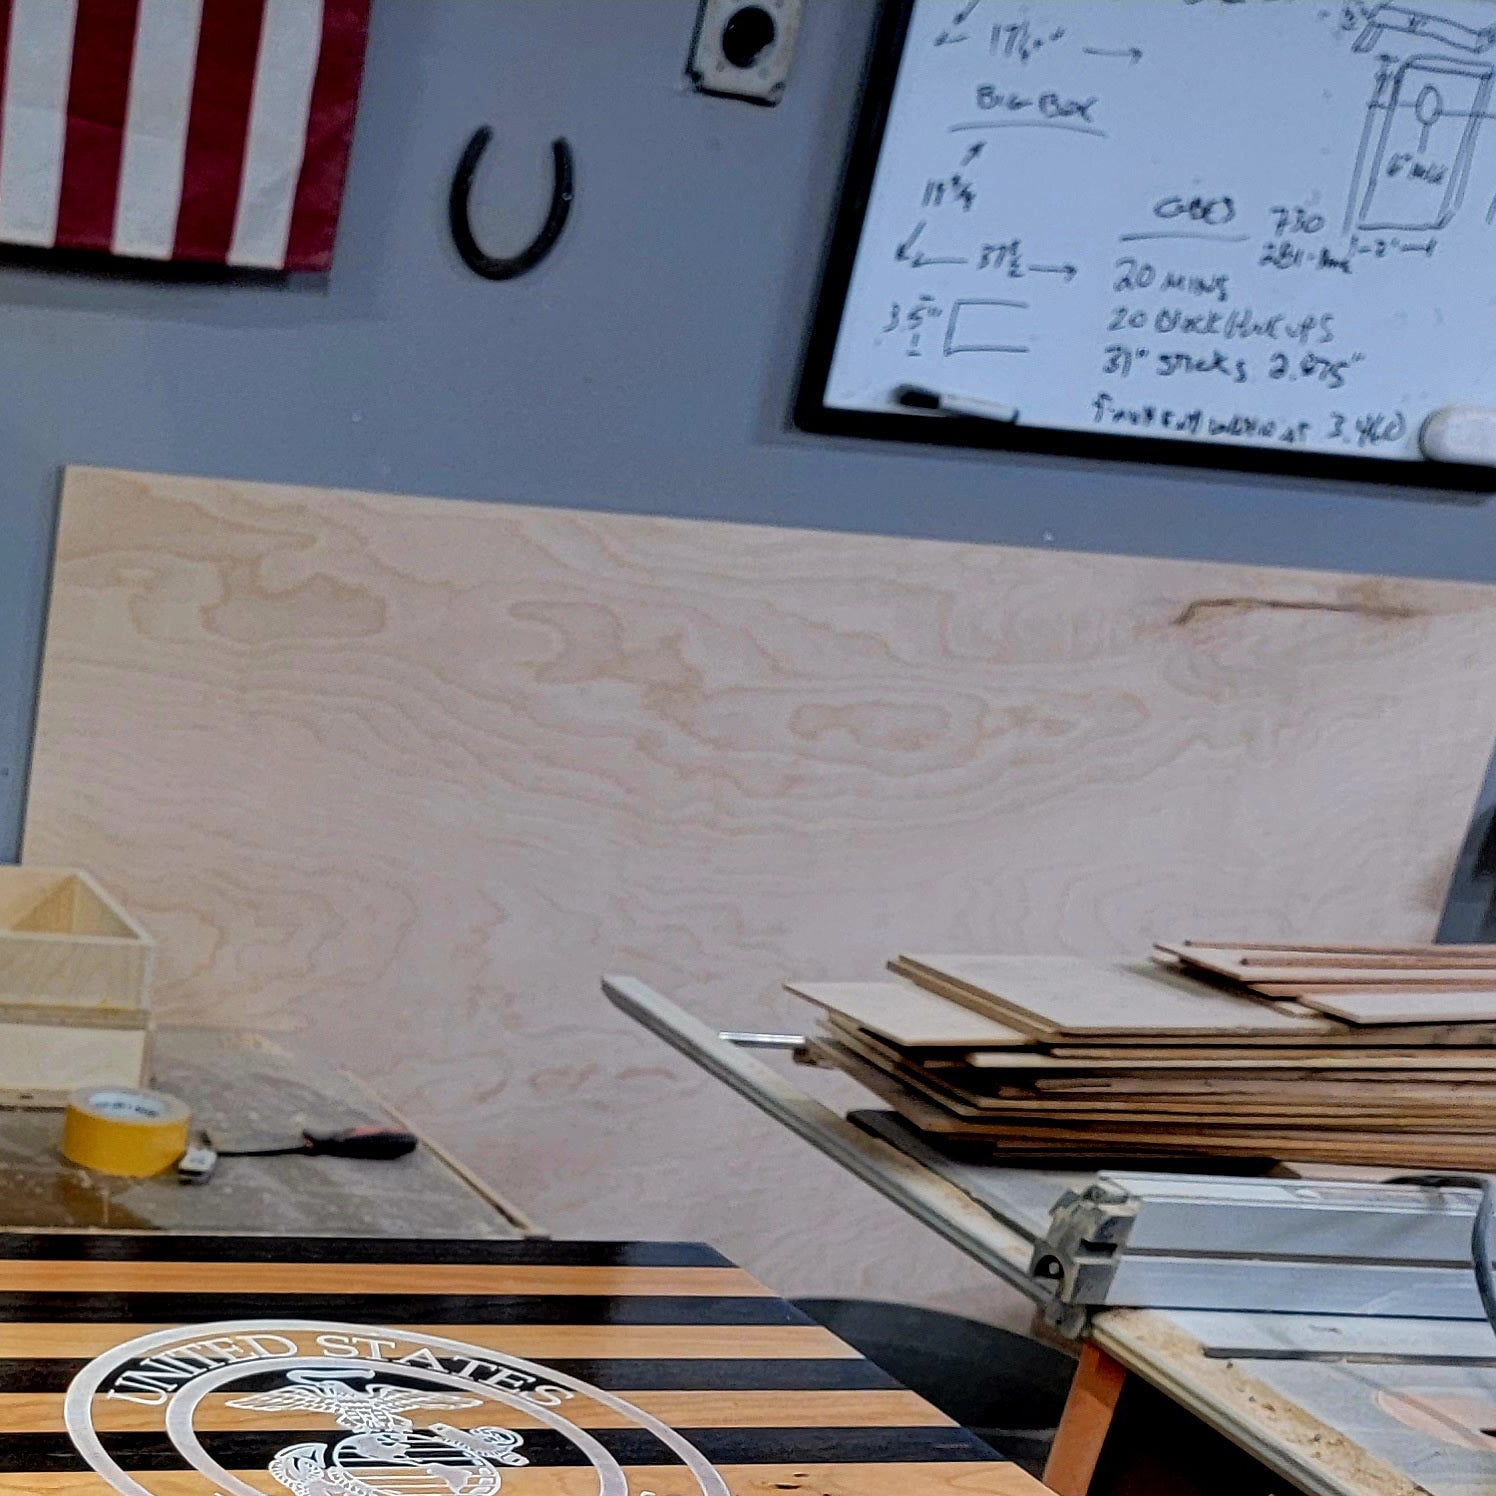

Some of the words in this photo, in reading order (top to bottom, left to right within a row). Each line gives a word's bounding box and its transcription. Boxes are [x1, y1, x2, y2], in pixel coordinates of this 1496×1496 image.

[1108, 305, 1149, 333] 20
[106, 1333, 299, 1408] UNITED
[314, 1333, 577, 1409] STATES
